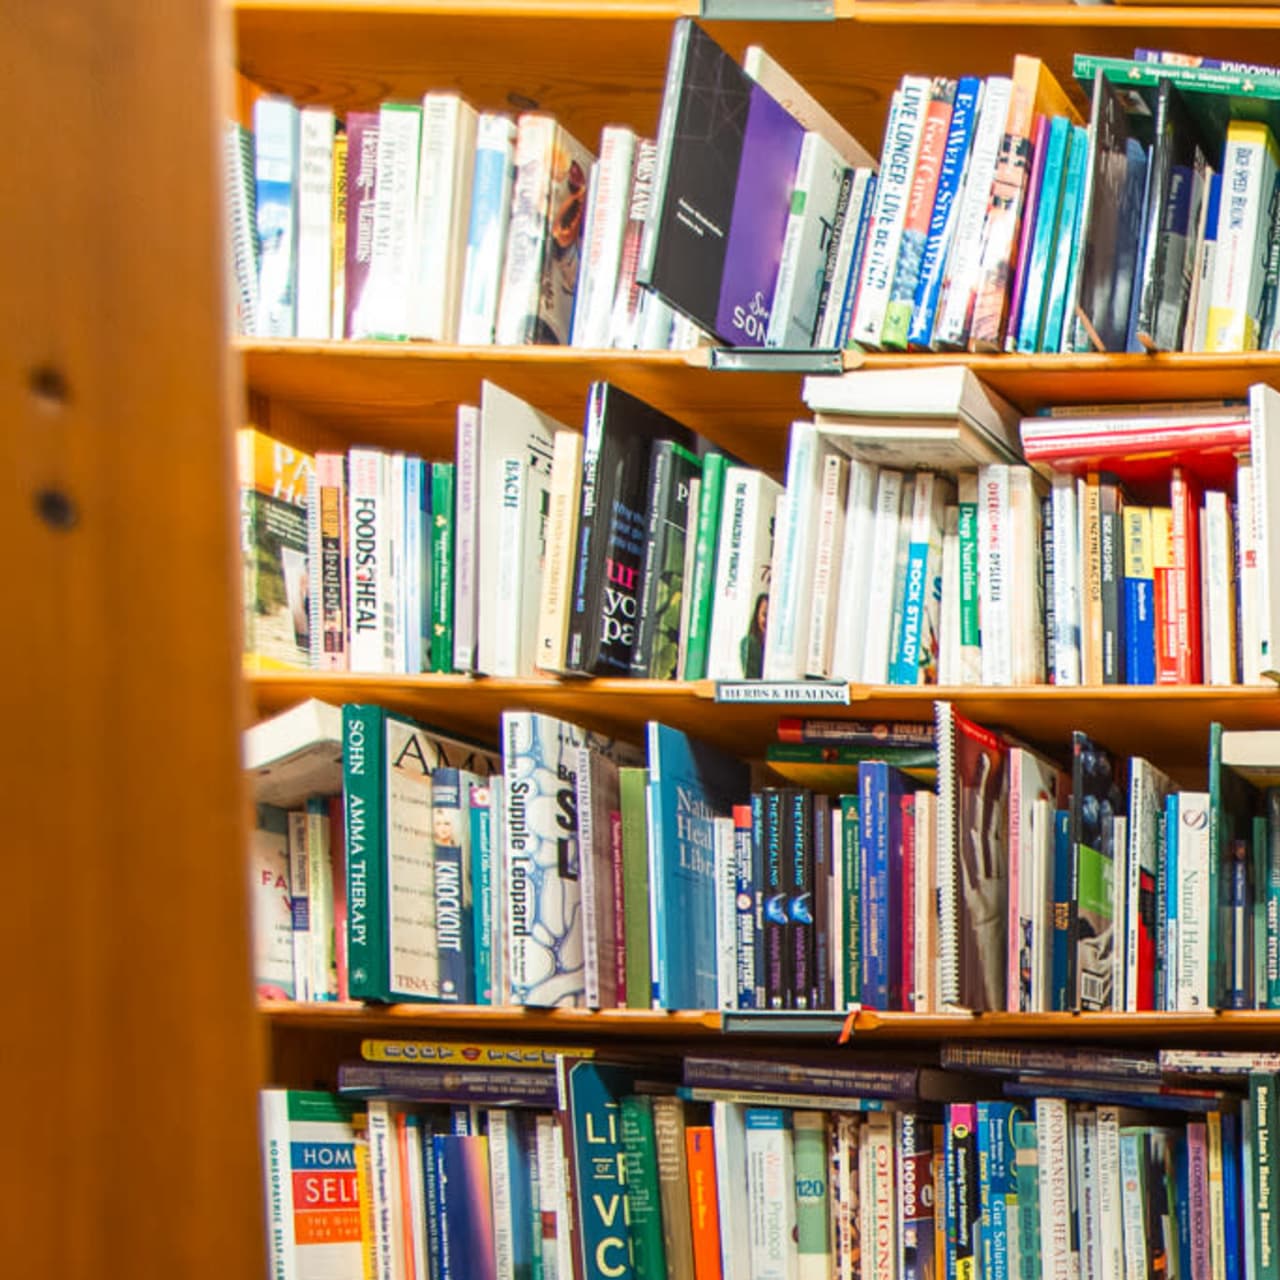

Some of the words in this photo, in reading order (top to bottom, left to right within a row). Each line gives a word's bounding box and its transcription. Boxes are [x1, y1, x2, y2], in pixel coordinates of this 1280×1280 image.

[950, 91, 976, 126] EAT
[940, 126, 968, 181] WELL
[932, 187, 955, 234] STAY
[919, 235, 946, 286] WELL
[503, 459, 520, 509] BACH
[1088, 491, 1099, 511] THE
[356, 498, 376, 566] FOODS
[958, 506, 975, 539] Deep
[986, 482, 1000, 550] OVERCOMING
[1089, 516, 1101, 556] ENZYME
[906, 558, 923, 602] ROCK
[961, 541, 977, 602] Nutrition
[988, 552, 1002, 602] DYSLEXIA
[1091, 558, 1101, 603] FACTOR
[356, 579, 377, 634] HEAL
[902, 605, 920, 666] STEADY
[724, 687, 767, 700] HERBS
[770, 688, 781, 700] &
[784, 687, 846, 700] HEALING
[348, 719, 365, 775] SOHN
[349, 793, 365, 854] AMMA
[768, 795, 779, 886] THETAHEALING
[793, 795, 804, 886] THETAHEALING
[350, 861, 366, 946] THERAPY
[435, 861, 462, 953] KNOCKOUT
[1181, 868, 1198, 926] Natural
[1179, 930, 1198, 988] Healing
[1257, 1086, 1269, 1127] Bottom
[1050, 1105, 1067, 1216] SPONTANEOUS
[1258, 1129, 1270, 1163] Line's
[992, 1199, 1006, 1228] Gut
[1258, 1166, 1270, 1209] Healing
[767, 1202, 782, 1260] Protocol
[1259, 1212, 1271, 1268] Remedies
